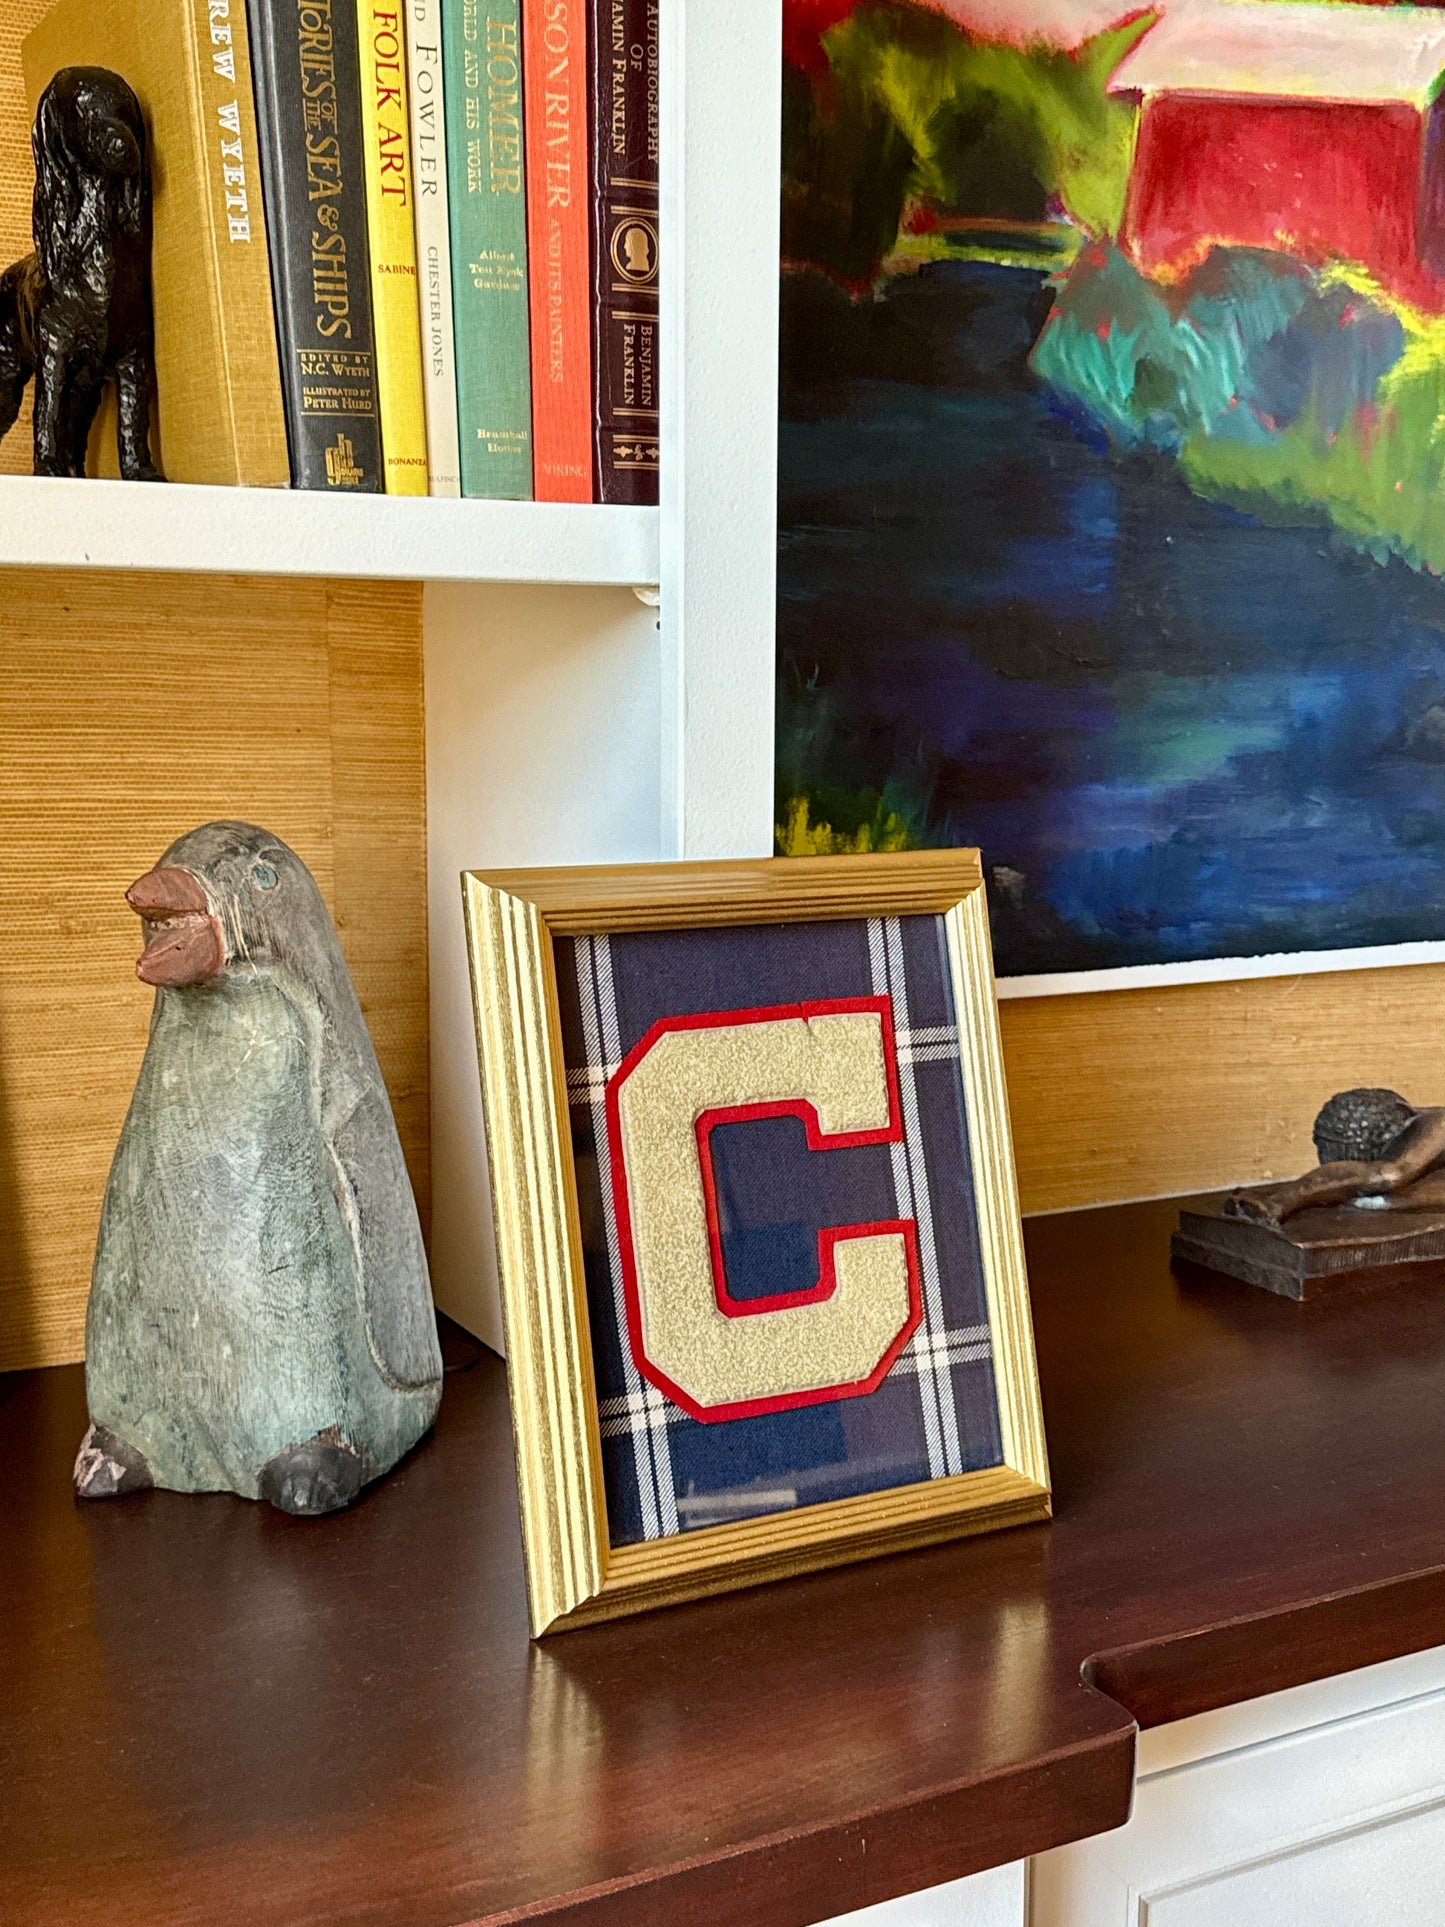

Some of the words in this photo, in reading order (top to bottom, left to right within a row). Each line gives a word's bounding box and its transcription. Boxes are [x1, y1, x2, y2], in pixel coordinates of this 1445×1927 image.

[373, 8, 402, 111] FOLK
[464, 49, 480, 89] AND
[630, 43, 643, 71] OF
[646, 3, 659, 164] AUTOBIOGRAPHY
[416, 41, 438, 197] FOWLER
[465, 97, 480, 130] HIS
[486, 15, 521, 195] HOMER
[612, 58, 627, 156] FRANKLIN
[217, 99, 251, 244] WYETH
[305, 133, 344, 201] SEA
[378, 122, 407, 208] ART
[467, 138, 483, 195] WORK
[545, 90, 571, 208] RIVER
[316, 203, 340, 232] &
[312, 231, 352, 340] SHIPS
[378, 264, 417, 276] SABINE
[427, 246, 441, 321] CHESTER
[300, 353, 348, 364] EDITED
[354, 355, 368, 365] BY
[301, 362, 329, 376] N.C.
[331, 364, 370, 377] WYETH
[431, 326, 444, 377] JONES
[549, 295, 564, 384] PAINTERS
[623, 324, 636, 405] FRANKLIN
[639, 325, 653, 406] BENJAMIN
[303, 386, 359, 397] ILLUSTRATED
[303, 396, 339, 409] PETER
[342, 398, 372, 410] HURD
[388, 457, 428, 467] BONANZA
[543, 462, 588, 477] VIKING
[605, 995, 922, 1425] C
